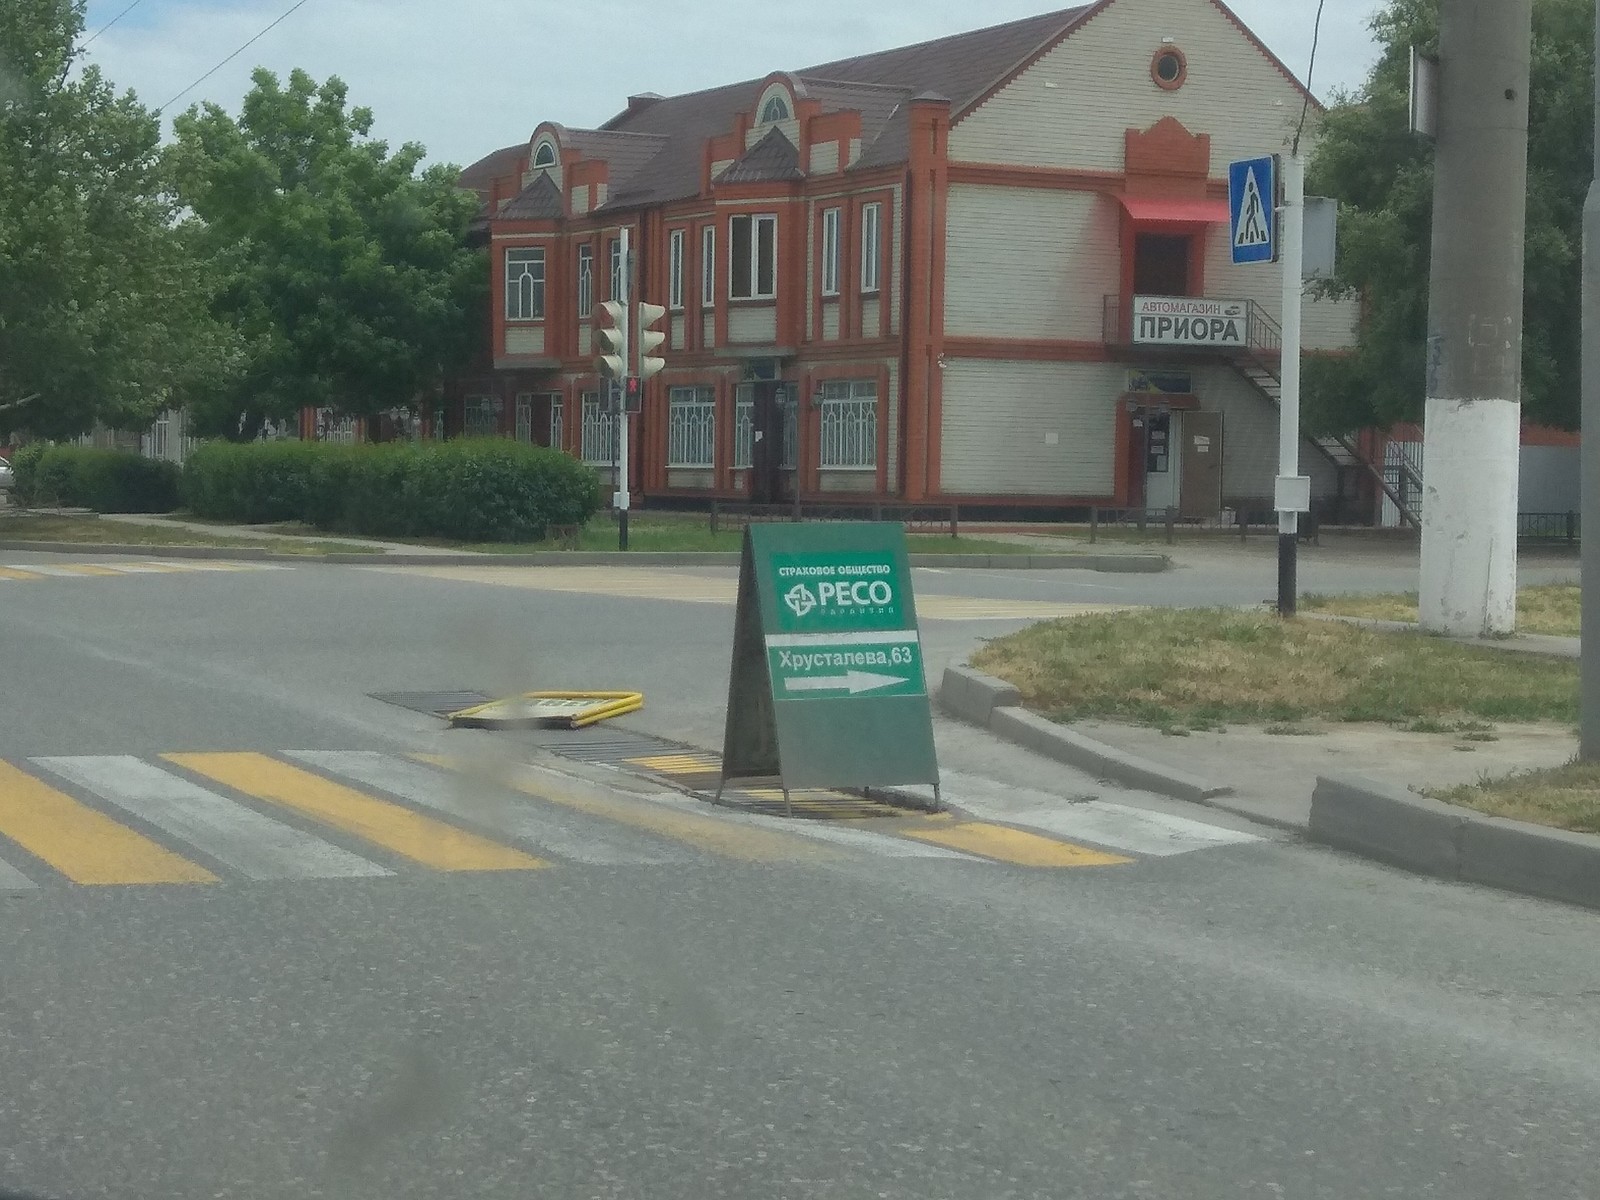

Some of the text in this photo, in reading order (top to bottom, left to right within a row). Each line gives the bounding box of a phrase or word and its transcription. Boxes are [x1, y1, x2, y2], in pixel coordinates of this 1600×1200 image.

[1142, 301, 1221, 315] АВТОМАГАЗИН
[1140, 316, 1239, 341] ПРИОРА
[778, 564, 891, 577] СТРАХОВОЕ ОБЩЕСТВО
[818, 580, 893, 606] РЕСО
